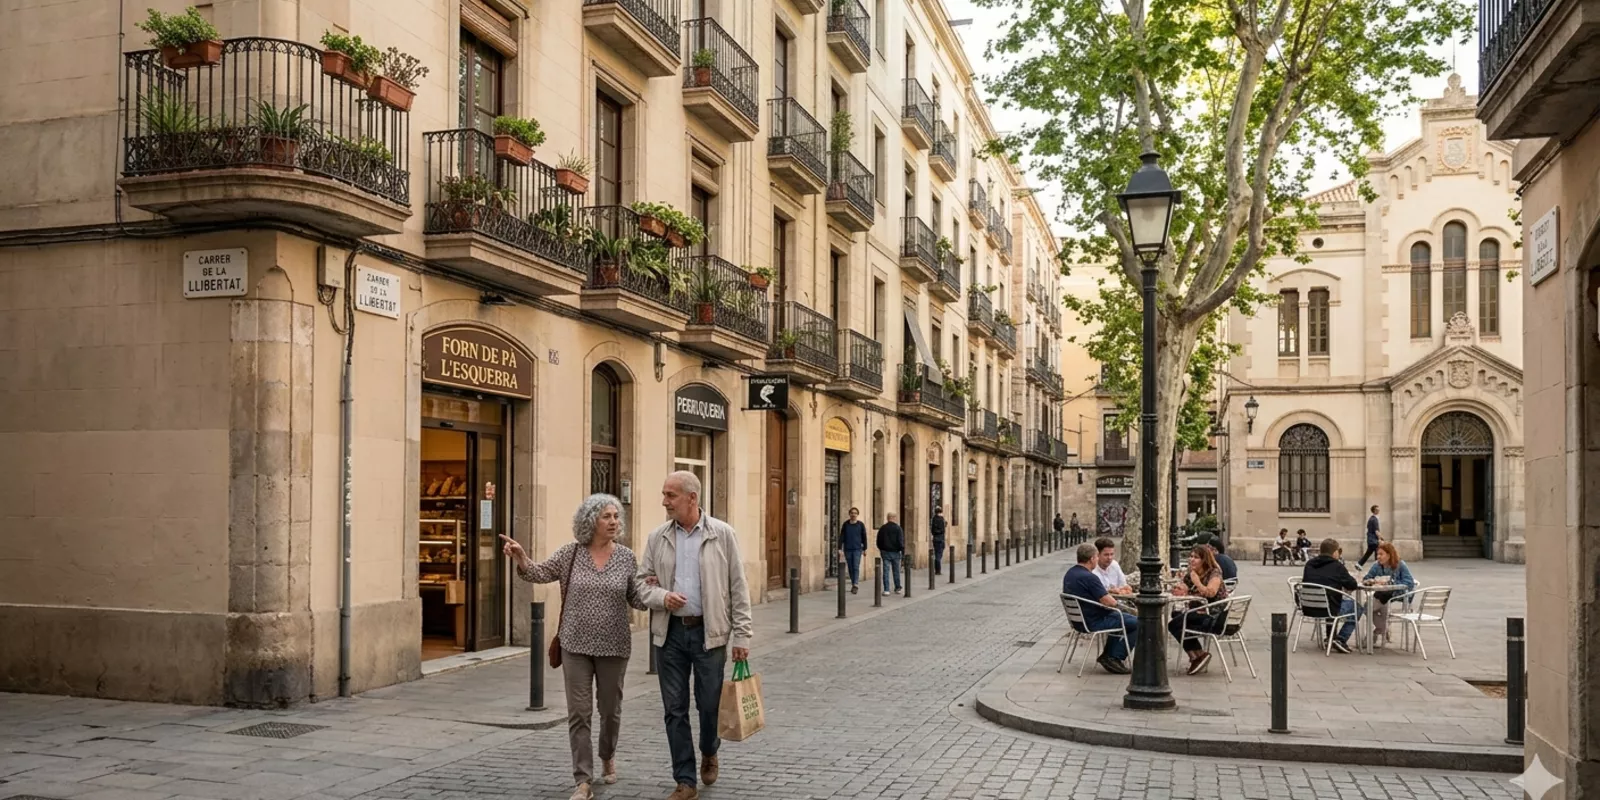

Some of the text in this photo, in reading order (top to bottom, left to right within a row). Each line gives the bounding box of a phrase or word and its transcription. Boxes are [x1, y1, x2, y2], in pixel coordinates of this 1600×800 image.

[198, 254, 231, 265] CARRER
[216, 266, 227, 276] LA
[188, 277, 241, 292] LLIBERTAT
[441, 336, 518, 369] FORN DE PÀ
[440, 358, 519, 390] L'ESQUEBRA
